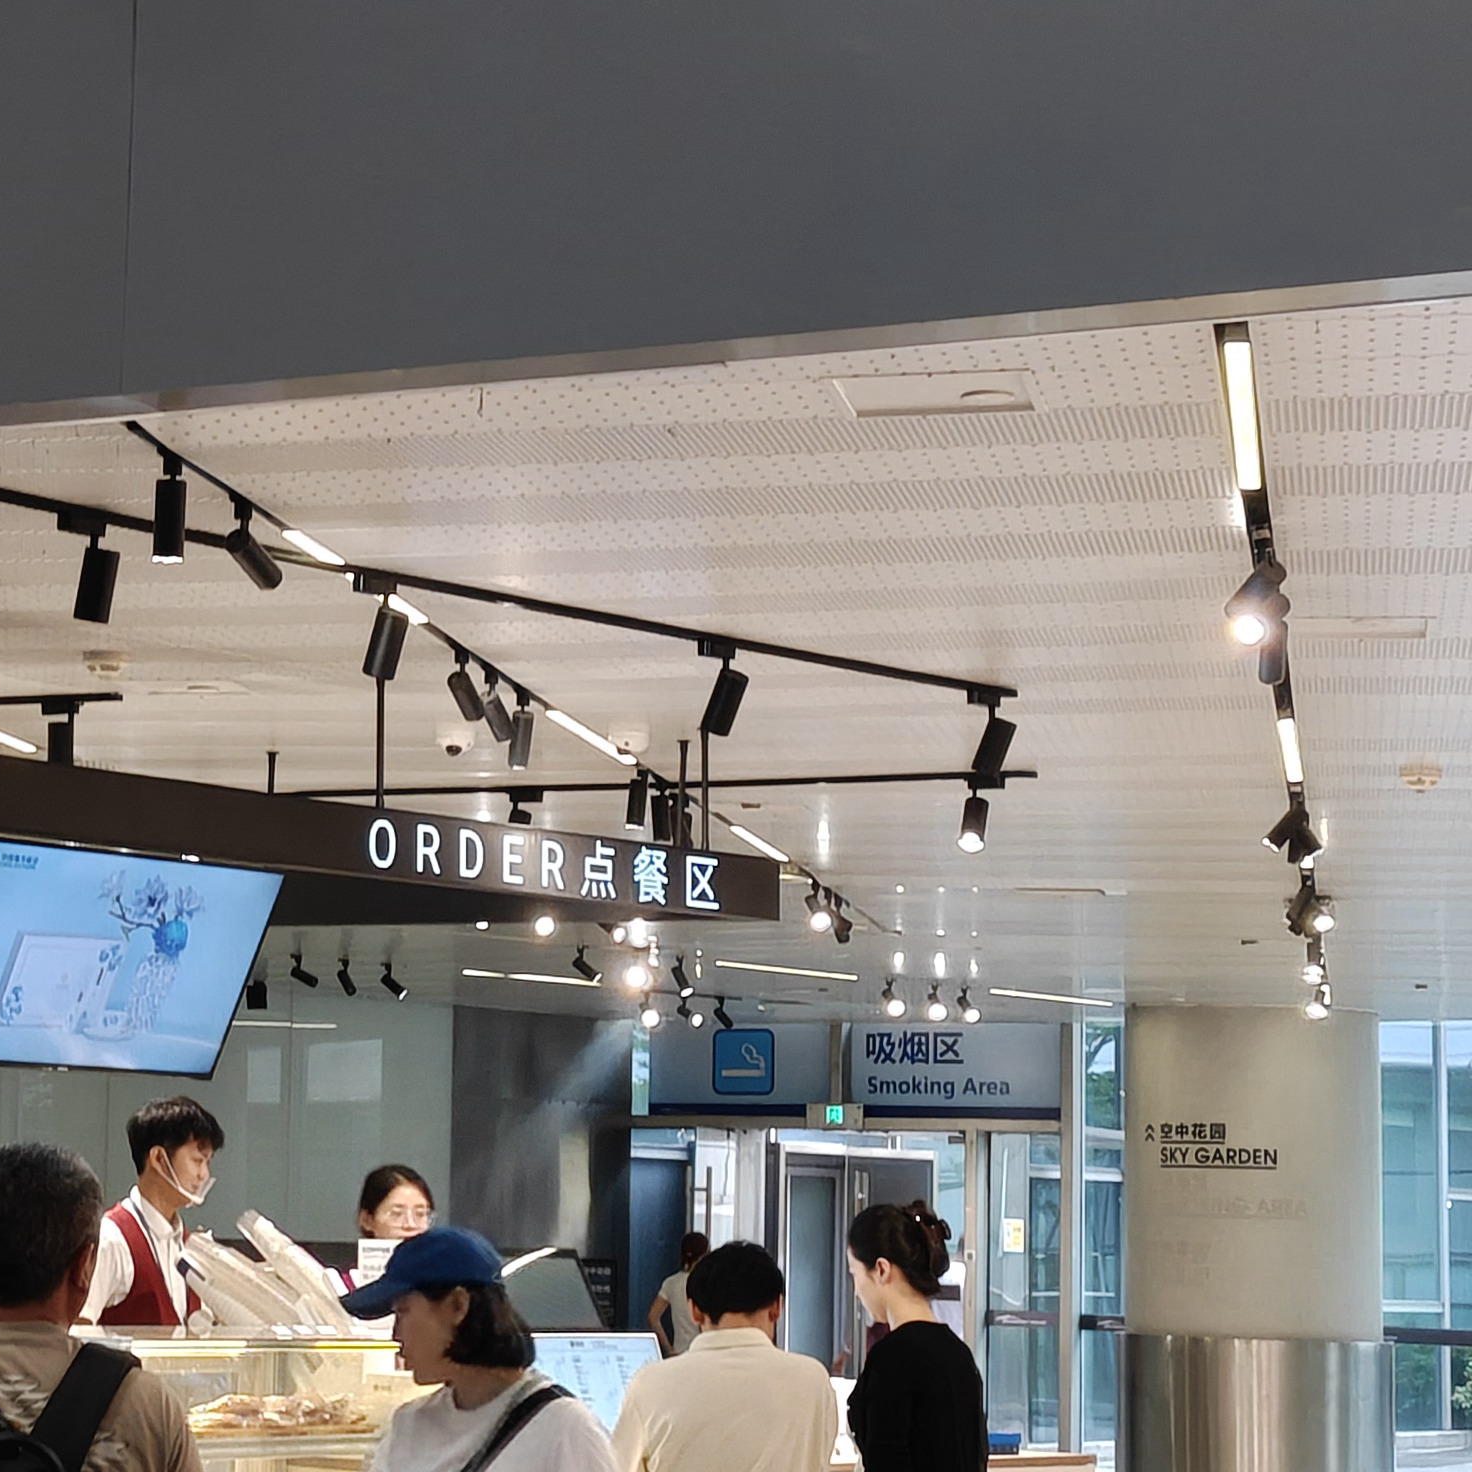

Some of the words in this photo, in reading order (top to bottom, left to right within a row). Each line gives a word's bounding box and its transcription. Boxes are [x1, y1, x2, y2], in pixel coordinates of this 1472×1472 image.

[866, 1030, 964, 1065] 吸烟区
[867, 1075, 955, 1100] Smoking
[962, 1077, 1010, 1096] Area
[1160, 1122, 1226, 1141] 空中花园
[1160, 1146, 1190, 1164] SKY
[1194, 1147, 1278, 1166] GARDEN
